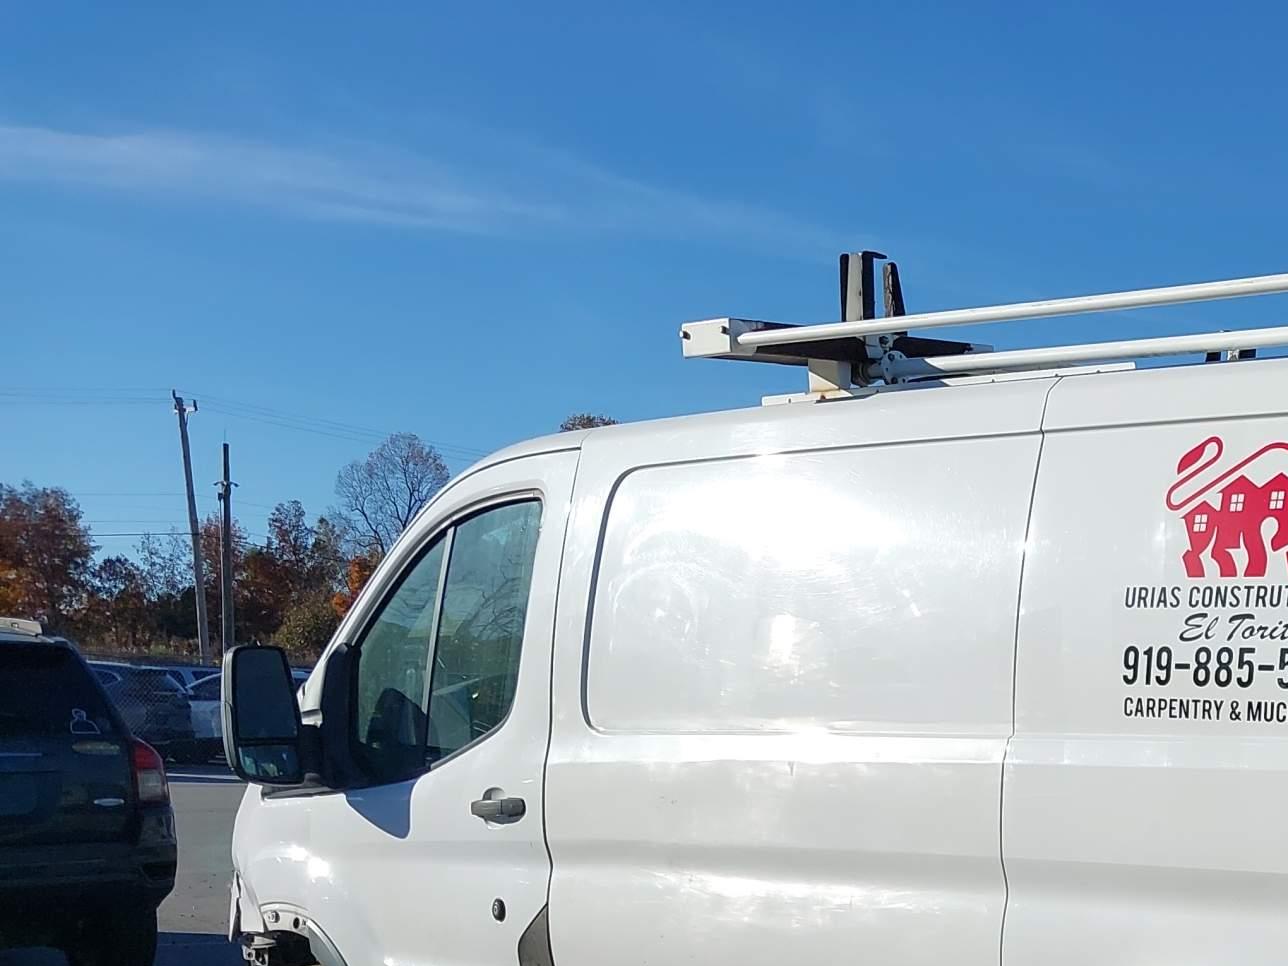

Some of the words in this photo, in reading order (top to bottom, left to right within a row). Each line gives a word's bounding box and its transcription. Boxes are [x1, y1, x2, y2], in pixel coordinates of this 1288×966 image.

[1124, 585, 1182, 609] URIAS
[1179, 612, 1219, 642] El
[1123, 696, 1225, 721] CARPENTRY
[1229, 700, 1242, 722] &
